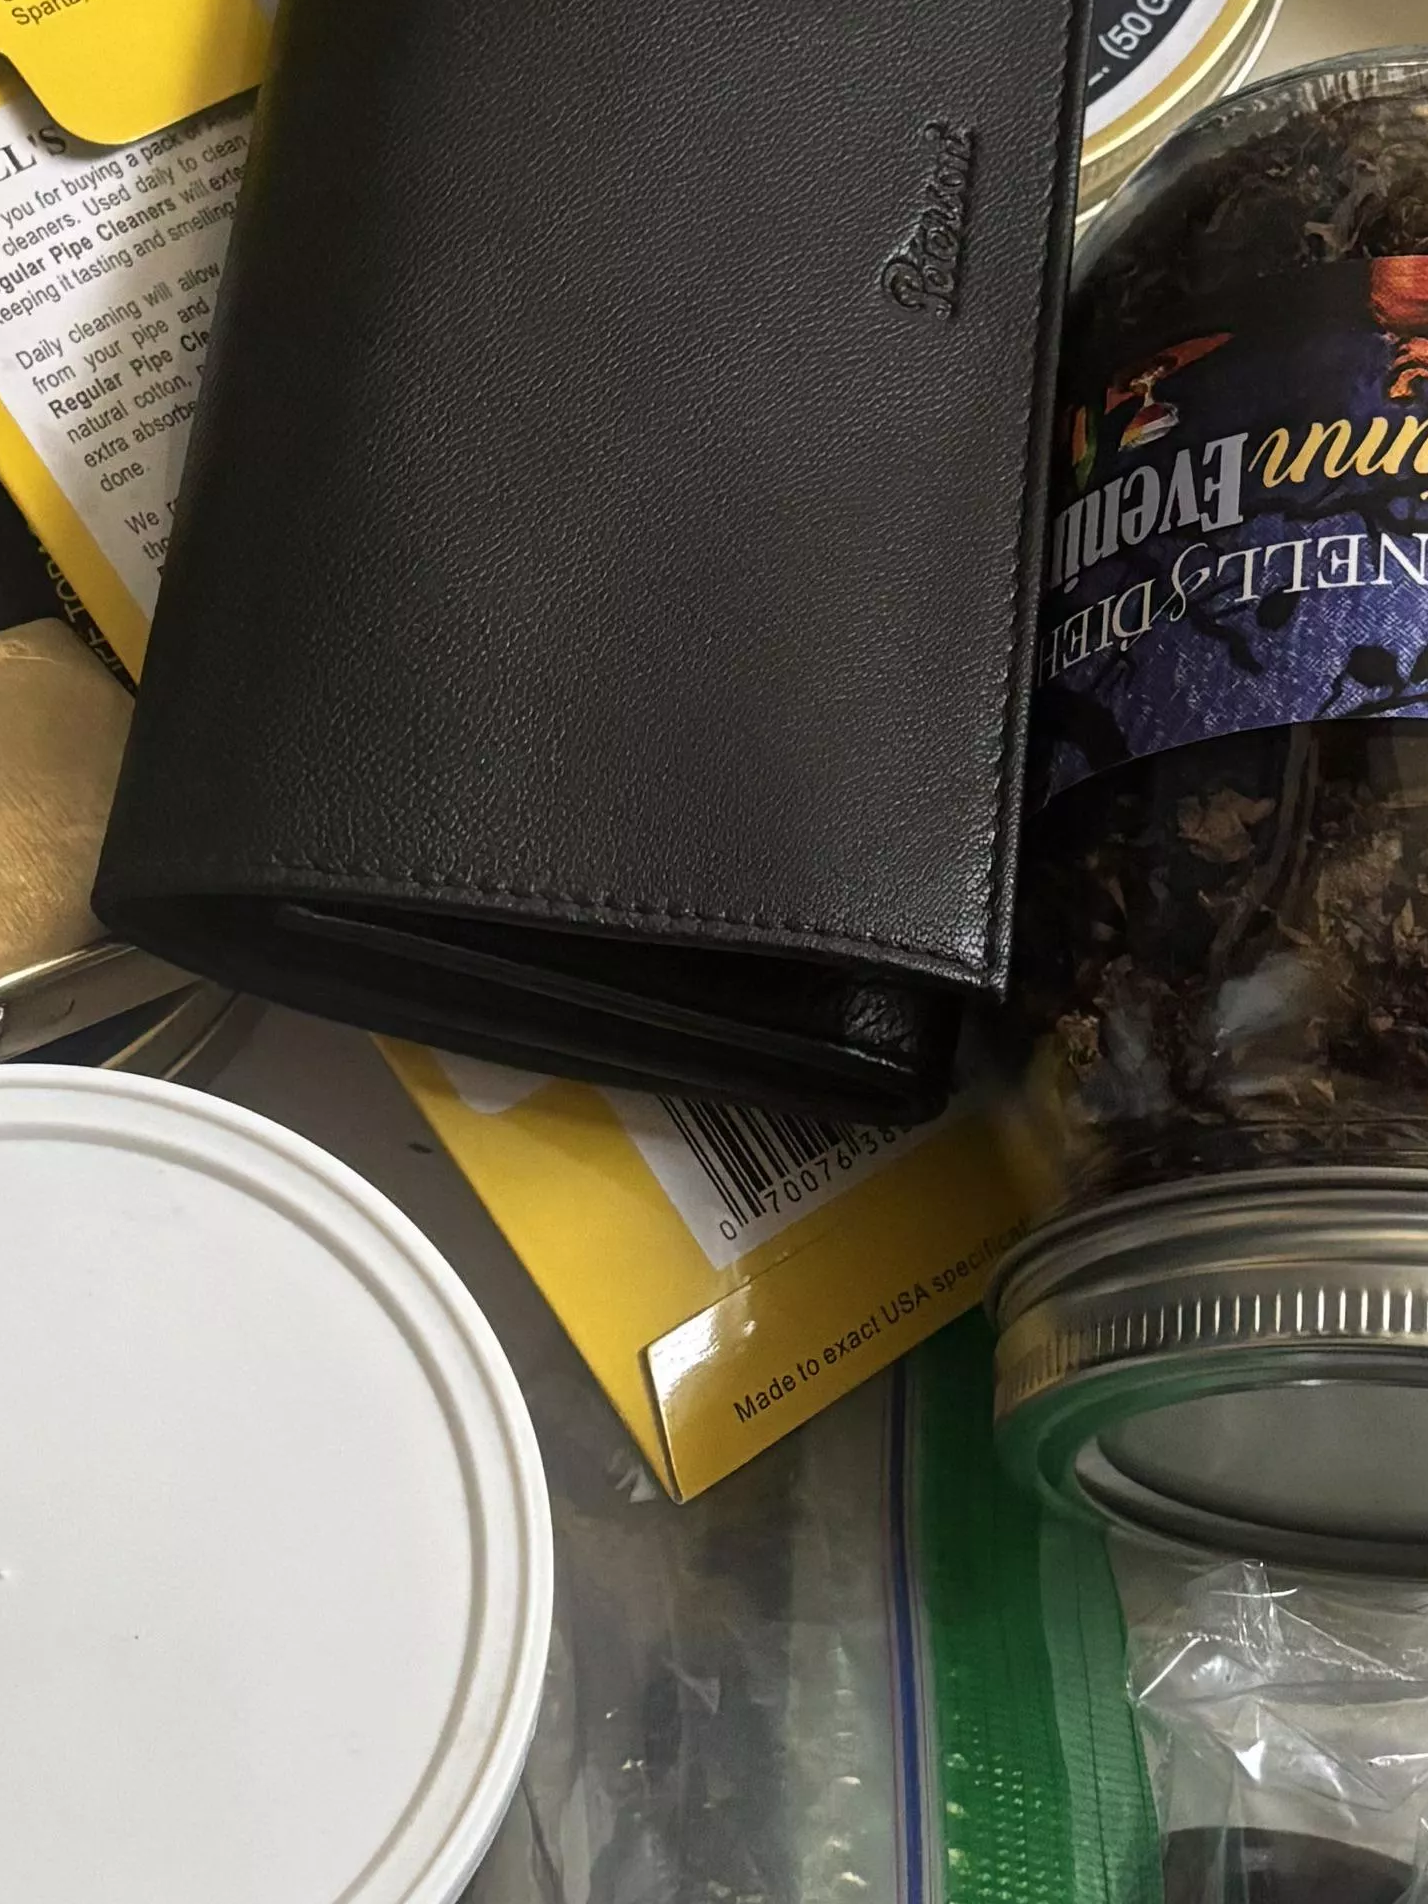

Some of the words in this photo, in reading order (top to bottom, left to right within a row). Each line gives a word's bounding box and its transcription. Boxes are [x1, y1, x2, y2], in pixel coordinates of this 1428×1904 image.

[0, 210, 81, 258] cleaners.
[81, 182, 132, 218] Used
[133, 164, 176, 196] daily
[176, 154, 198, 174] to
[200, 132, 248, 164] clean
[33, 184, 62, 210] for
[61, 157, 124, 198] buying
[124, 152, 140, 168] a
[138, 129, 182, 163] pack
[49, 233, 95, 266] Pipe
[94, 194, 177, 242] Cleaners
[178, 178, 209, 204] will
[56, 272, 75, 292] it
[72, 247, 134, 288] tasting
[131, 230, 166, 258] and
[15, 336, 65, 372] Daily
[66, 298, 142, 346] cleaning
[141, 282, 174, 308] will
[176, 260, 221, 292] allow
[31, 362, 76, 396] from
[82, 340, 124, 372] your
[130, 318, 170, 349] pipe
[175, 294, 210, 324] and
[47, 371, 124, 421] Regular
[129, 346, 174, 378] Pipe
[65, 399, 129, 444] natural
[132, 372, 192, 410] cotton,
[82, 434, 130, 468] extra
[98, 458, 148, 492] done.
[123, 508, 160, 536] We
[1051, 434, 1247, 595] Eveni
[1151, 543, 1214, 623] &
[1037, 579, 1151, 688] DIEH
[717, 1217, 739, 1242] 0
[762, 1148, 854, 1215] 70076
[731, 1371, 798, 1423] Made
[794, 1354, 822, 1382] to
[820, 1314, 882, 1366] exact
[878, 1281, 931, 1325] USA
